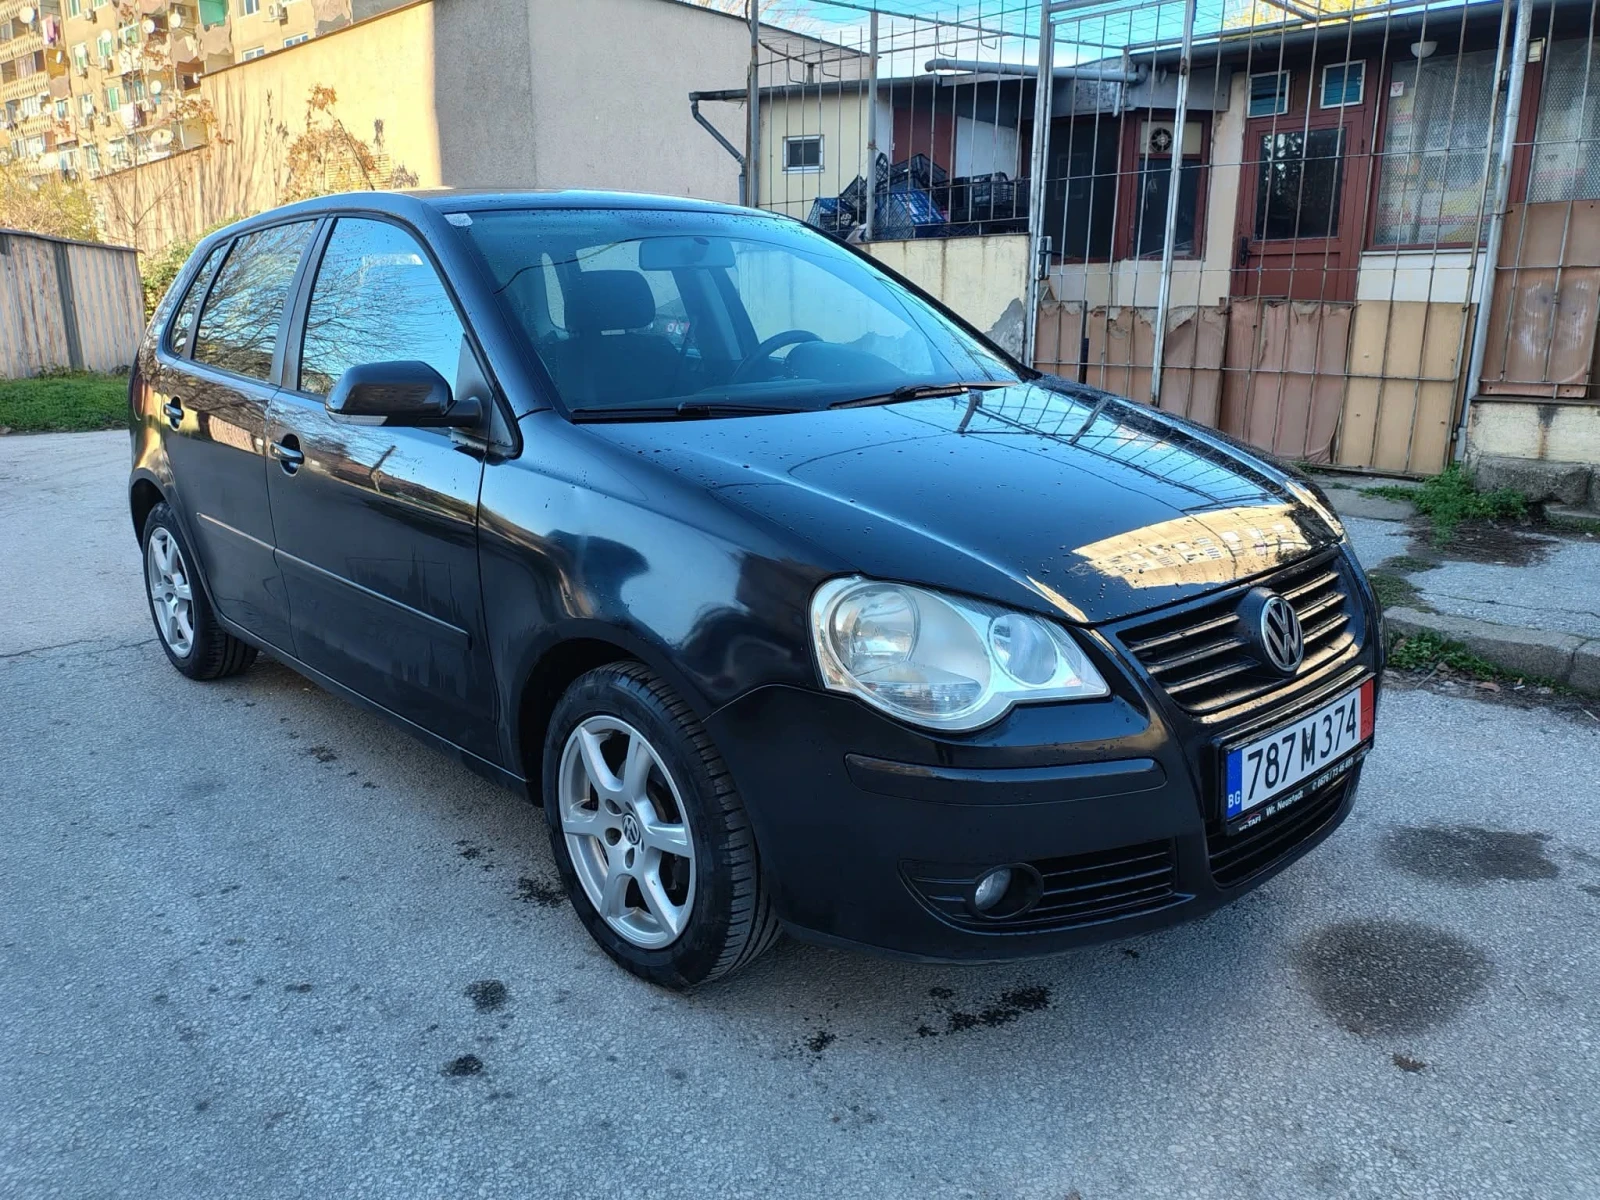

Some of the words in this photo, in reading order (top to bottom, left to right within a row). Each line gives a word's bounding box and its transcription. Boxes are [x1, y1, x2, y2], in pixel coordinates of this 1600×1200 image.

[1247, 732, 1296, 801] 787
[1300, 721, 1317, 772] M
[1320, 697, 1357, 759] 374
[1228, 790, 1241, 809] BG
